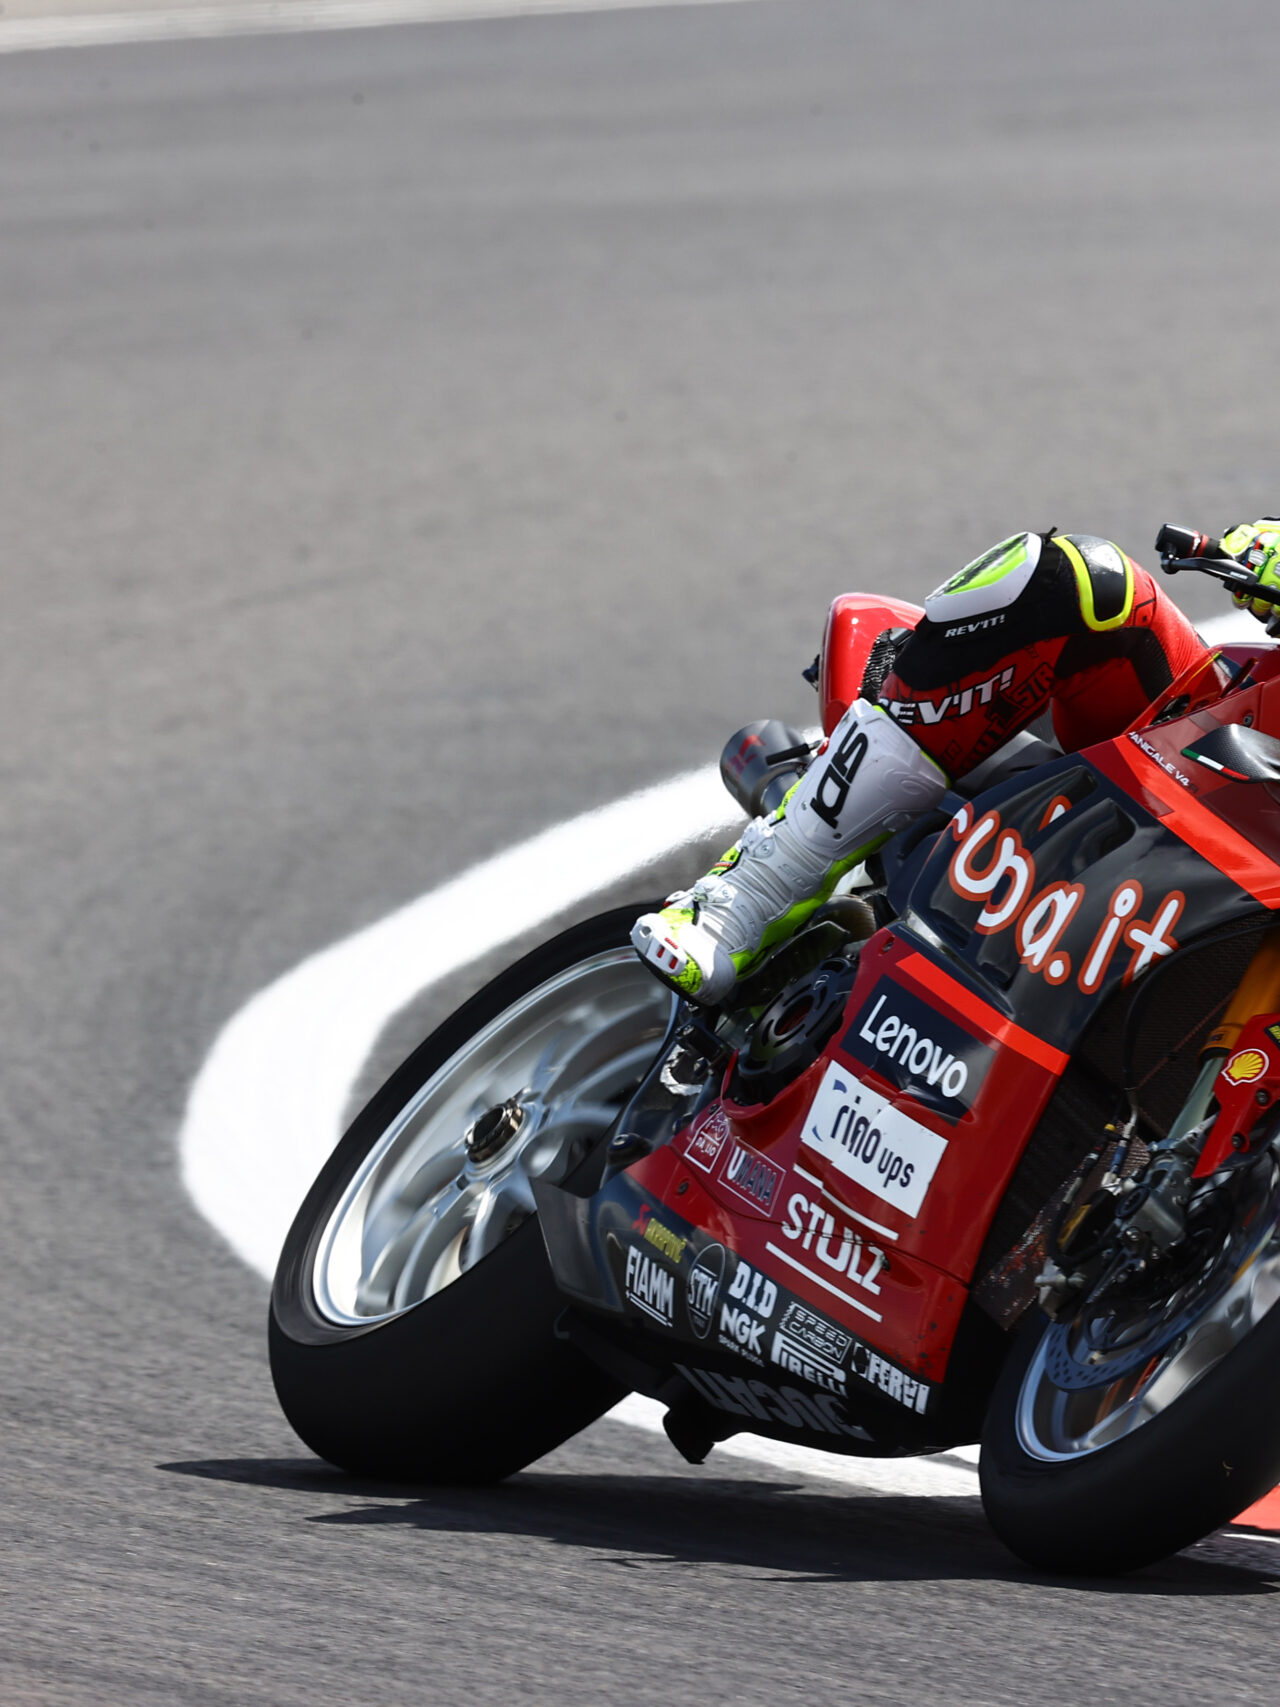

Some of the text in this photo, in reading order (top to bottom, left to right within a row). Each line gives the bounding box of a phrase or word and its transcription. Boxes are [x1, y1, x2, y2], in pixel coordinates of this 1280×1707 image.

[945, 615, 1005, 638] REV'IT!
[859, 994, 968, 1098] Lenovo
[727, 1146, 777, 1206] UMANA
[877, 1147, 914, 1188] ups
[781, 1193, 881, 1296] STULZ
[625, 1244, 675, 1319] FIAMM
[688, 1268, 720, 1317] STM
[728, 1261, 778, 1319] D.I.D
[720, 1303, 766, 1355] NGK
[795, 1311, 847, 1347] SPEED
[770, 1331, 847, 1398] PIRELLI
